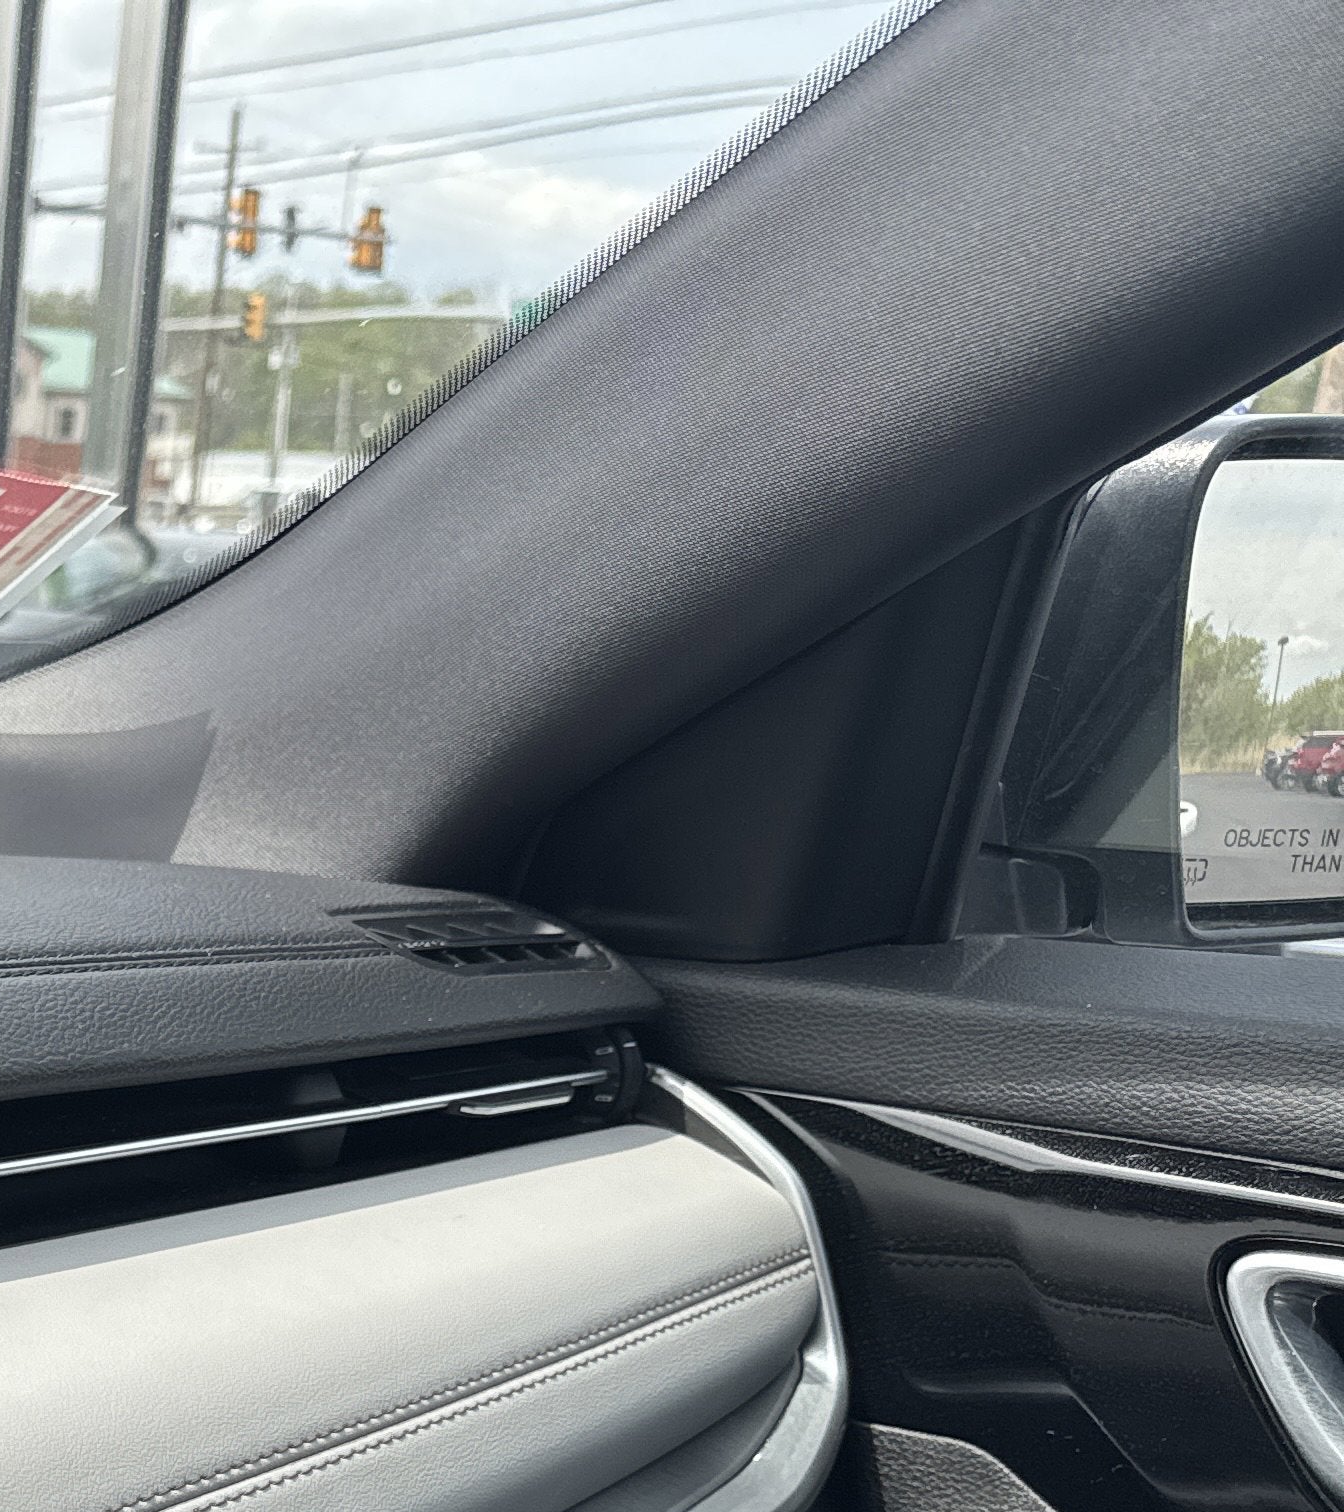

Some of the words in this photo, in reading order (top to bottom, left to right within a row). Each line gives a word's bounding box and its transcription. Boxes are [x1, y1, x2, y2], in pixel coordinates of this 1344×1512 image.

[1223, 827, 1311, 848] OBJECTS
[1320, 827, 1340, 847] IN
[1291, 854, 1342, 873] THAN
